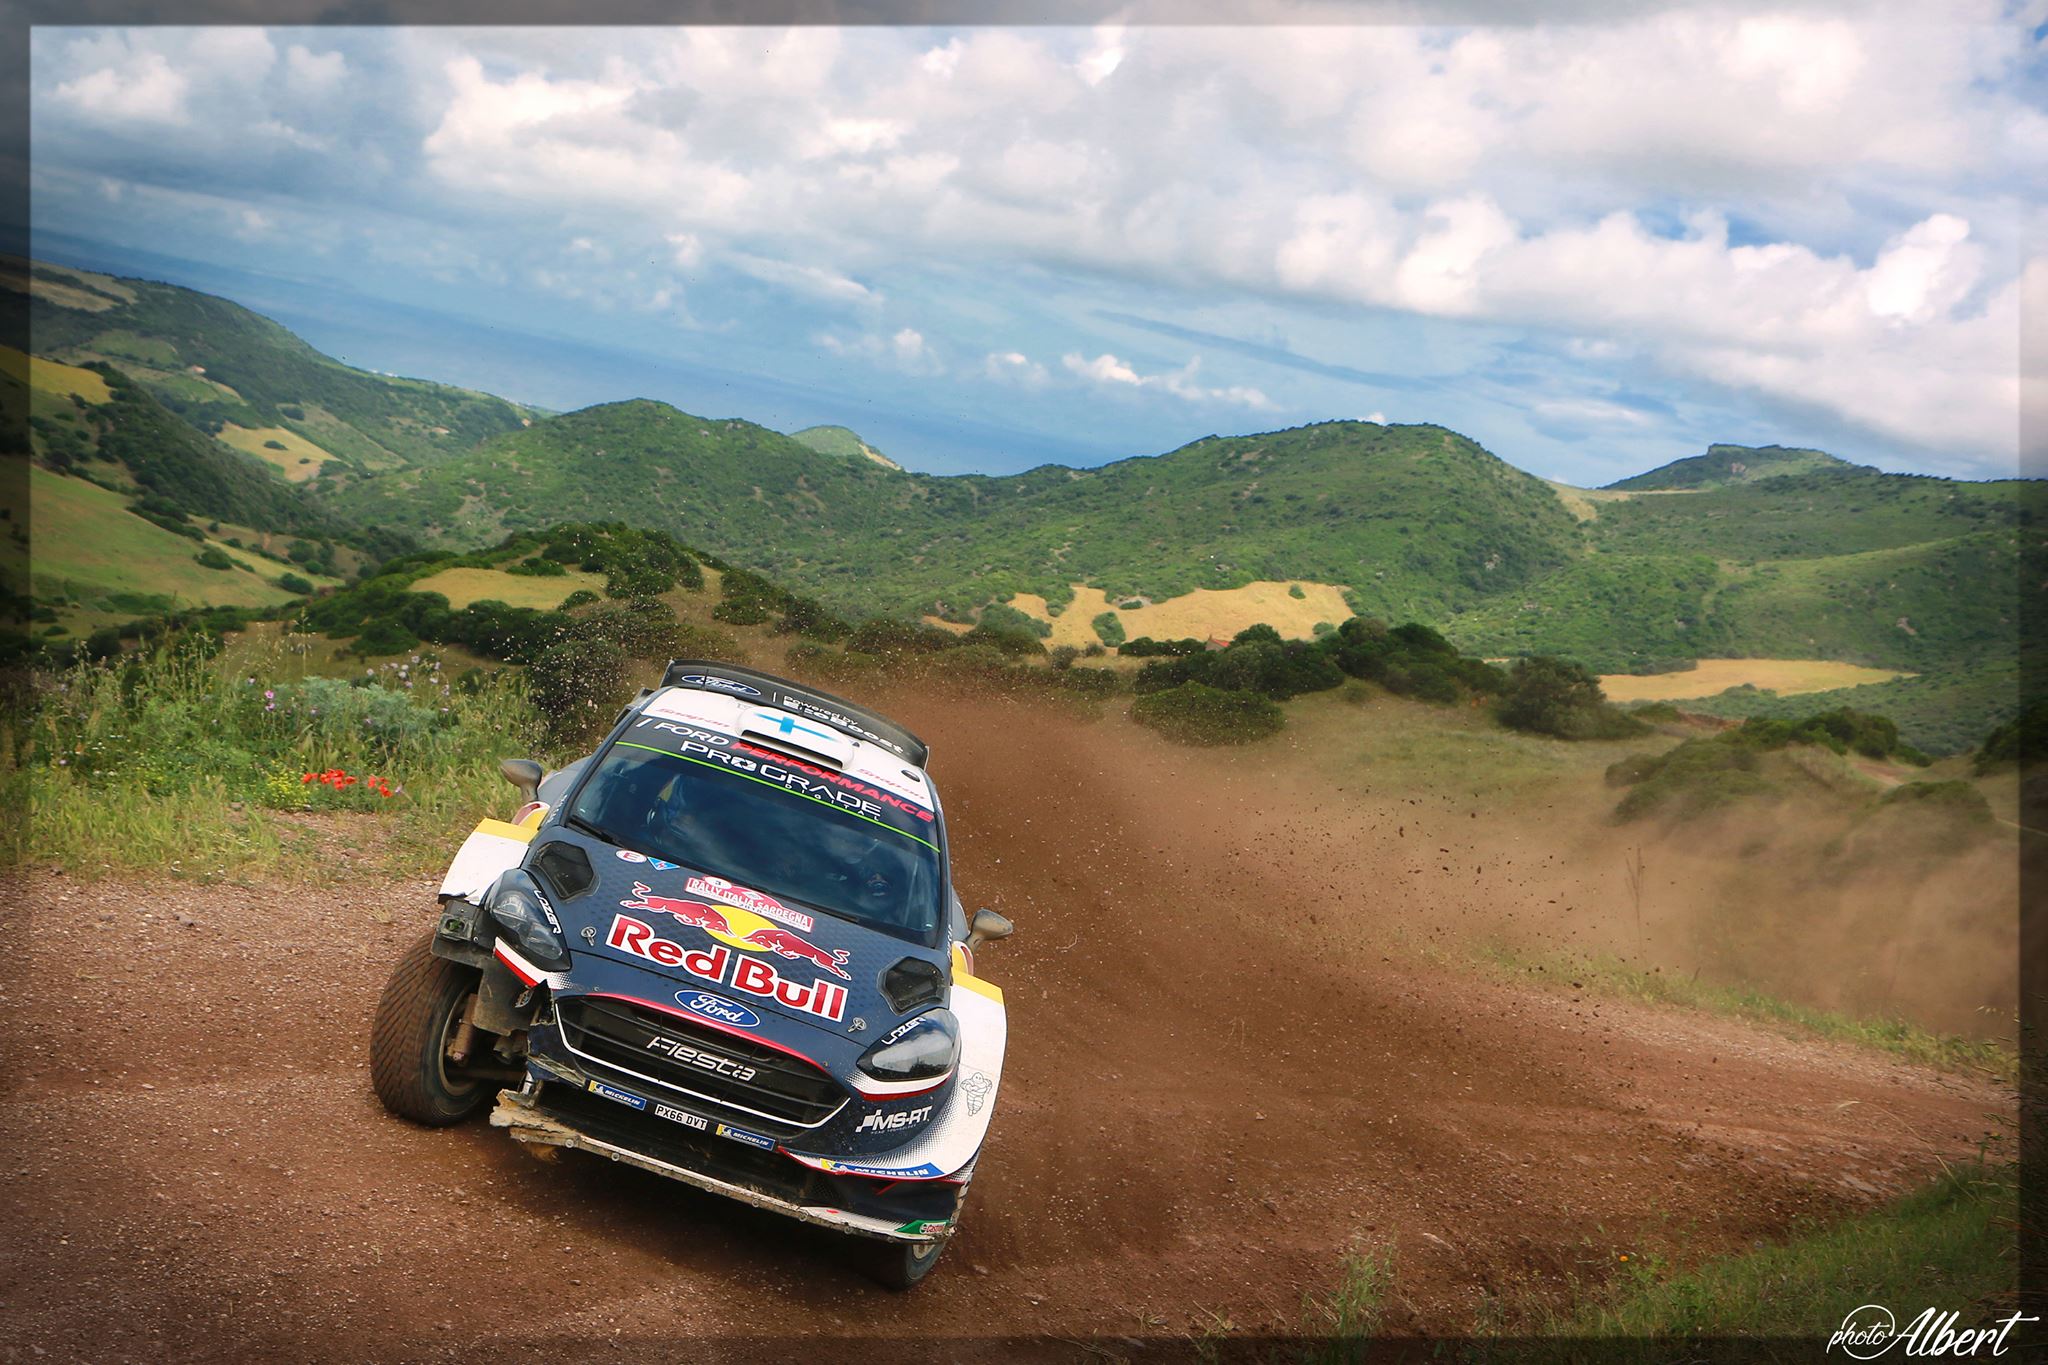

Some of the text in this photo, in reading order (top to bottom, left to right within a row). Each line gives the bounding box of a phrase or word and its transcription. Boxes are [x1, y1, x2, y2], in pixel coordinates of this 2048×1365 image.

[784, 695, 859, 726] Powered by
[654, 721, 935, 824] FORD PERFORMANCE
[784, 783, 880, 822] DIGITAL
[691, 877, 722, 896] RALLY
[723, 890, 755, 908] ITALIA
[755, 900, 809, 927] SARDEGNA
[607, 914, 848, 1021] Red Bull
[690, 994, 746, 1023] Ford
[646, 1036, 757, 1083] Fiesta
[604, 1088, 641, 1106] MICHELIN
[656, 1105, 707, 1129] PX66 DVT
[872, 1105, 933, 1131] MS-RT
[732, 1130, 769, 1148] MICHELIN
[853, 1168, 929, 1177] MICHELIN
